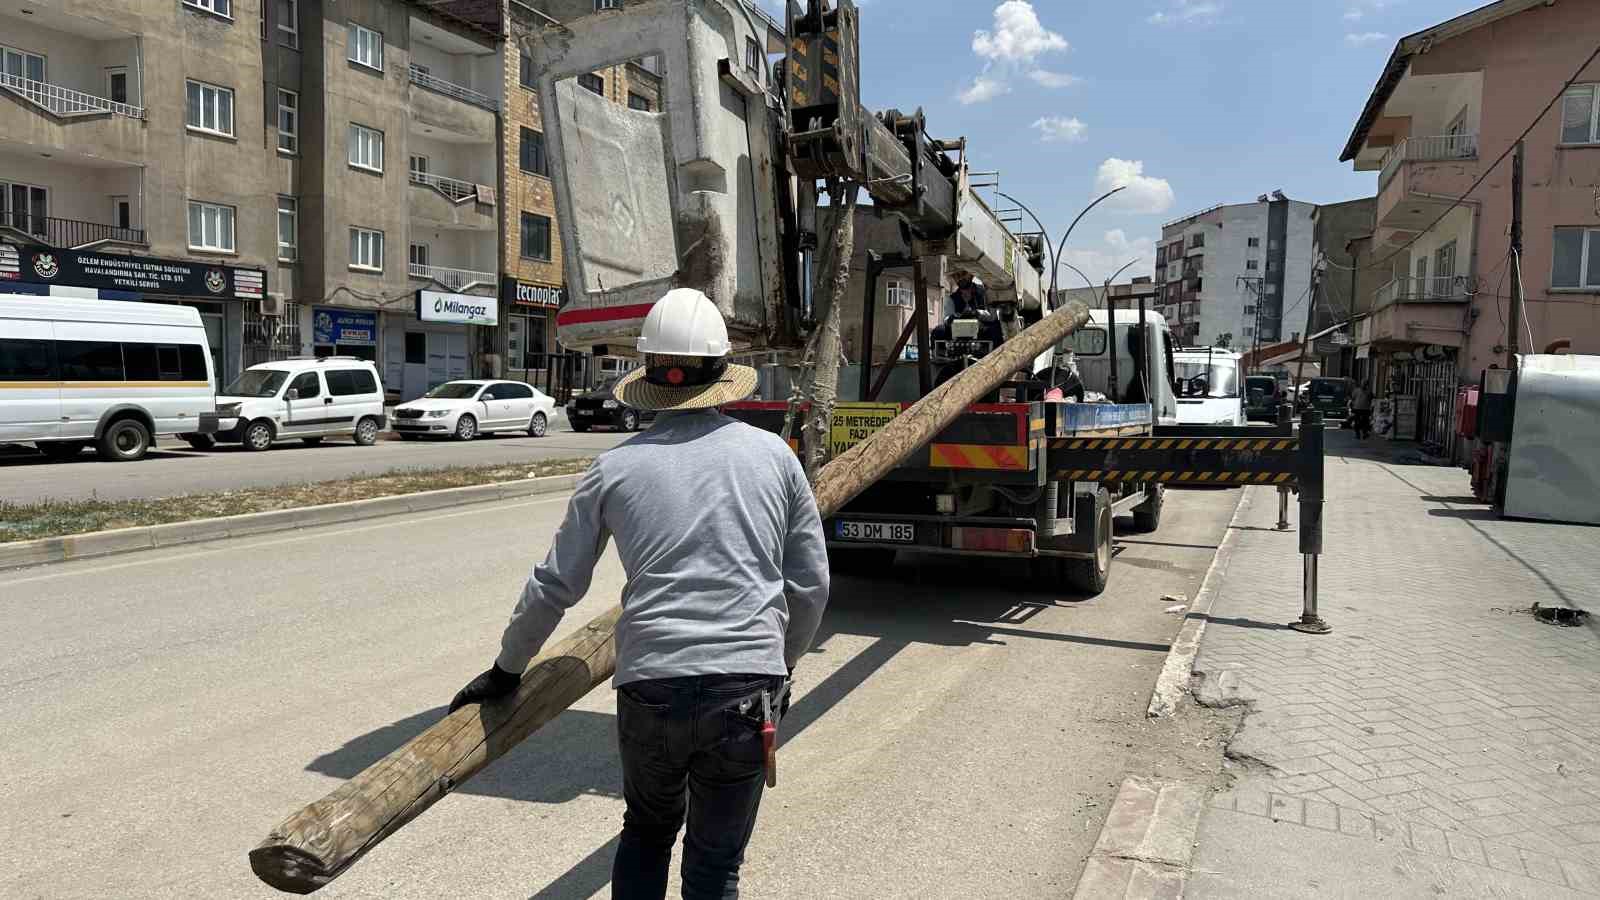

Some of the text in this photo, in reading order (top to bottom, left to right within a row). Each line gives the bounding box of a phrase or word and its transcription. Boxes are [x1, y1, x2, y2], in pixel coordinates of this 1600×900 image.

[77, 256, 100, 265] ÖZLEM
[85, 267, 132, 277] HAVALANDIRMA
[443, 301, 487, 319] Milangaz
[833, 415, 844, 426] 25
[842, 522, 912, 539] 53 DM 185
